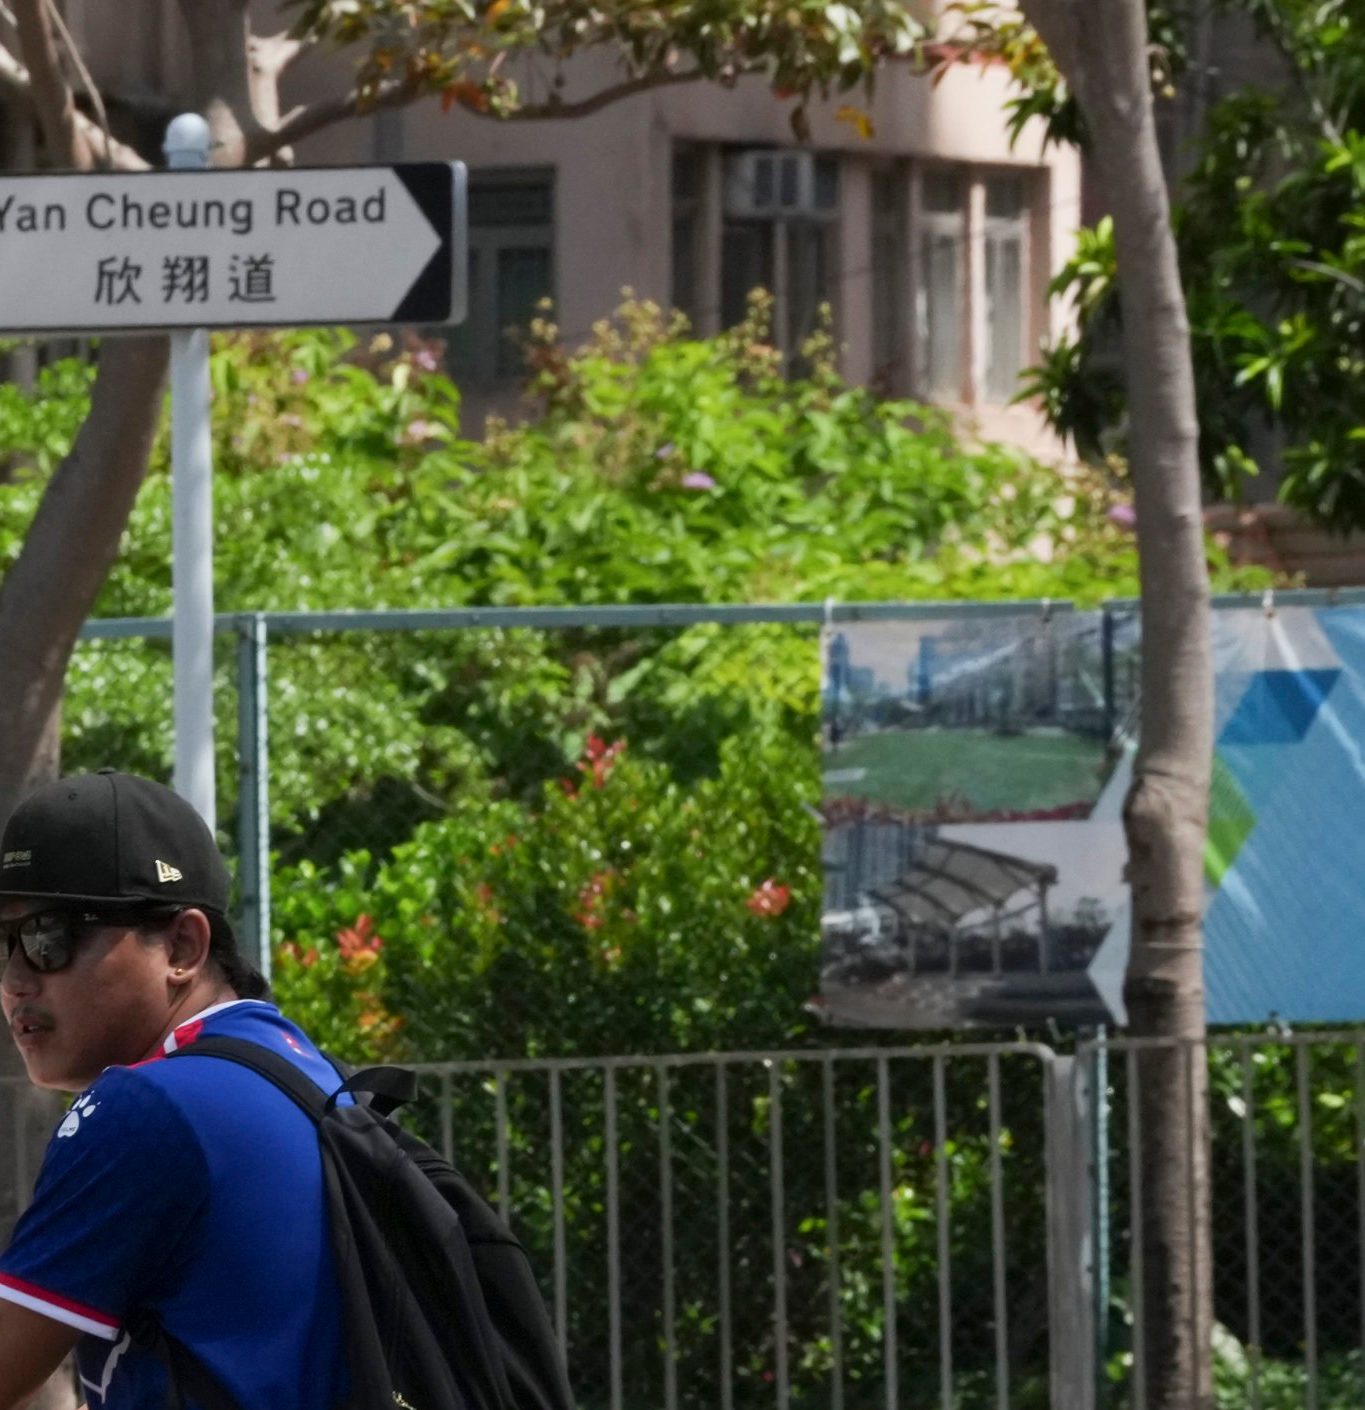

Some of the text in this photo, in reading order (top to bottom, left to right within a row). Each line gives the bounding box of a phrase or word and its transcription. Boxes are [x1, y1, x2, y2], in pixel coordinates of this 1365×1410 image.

[85, 192, 253, 236] Cheung
[275, 186, 386, 226] Road
[94, 253, 277, 306] 欣翔道
